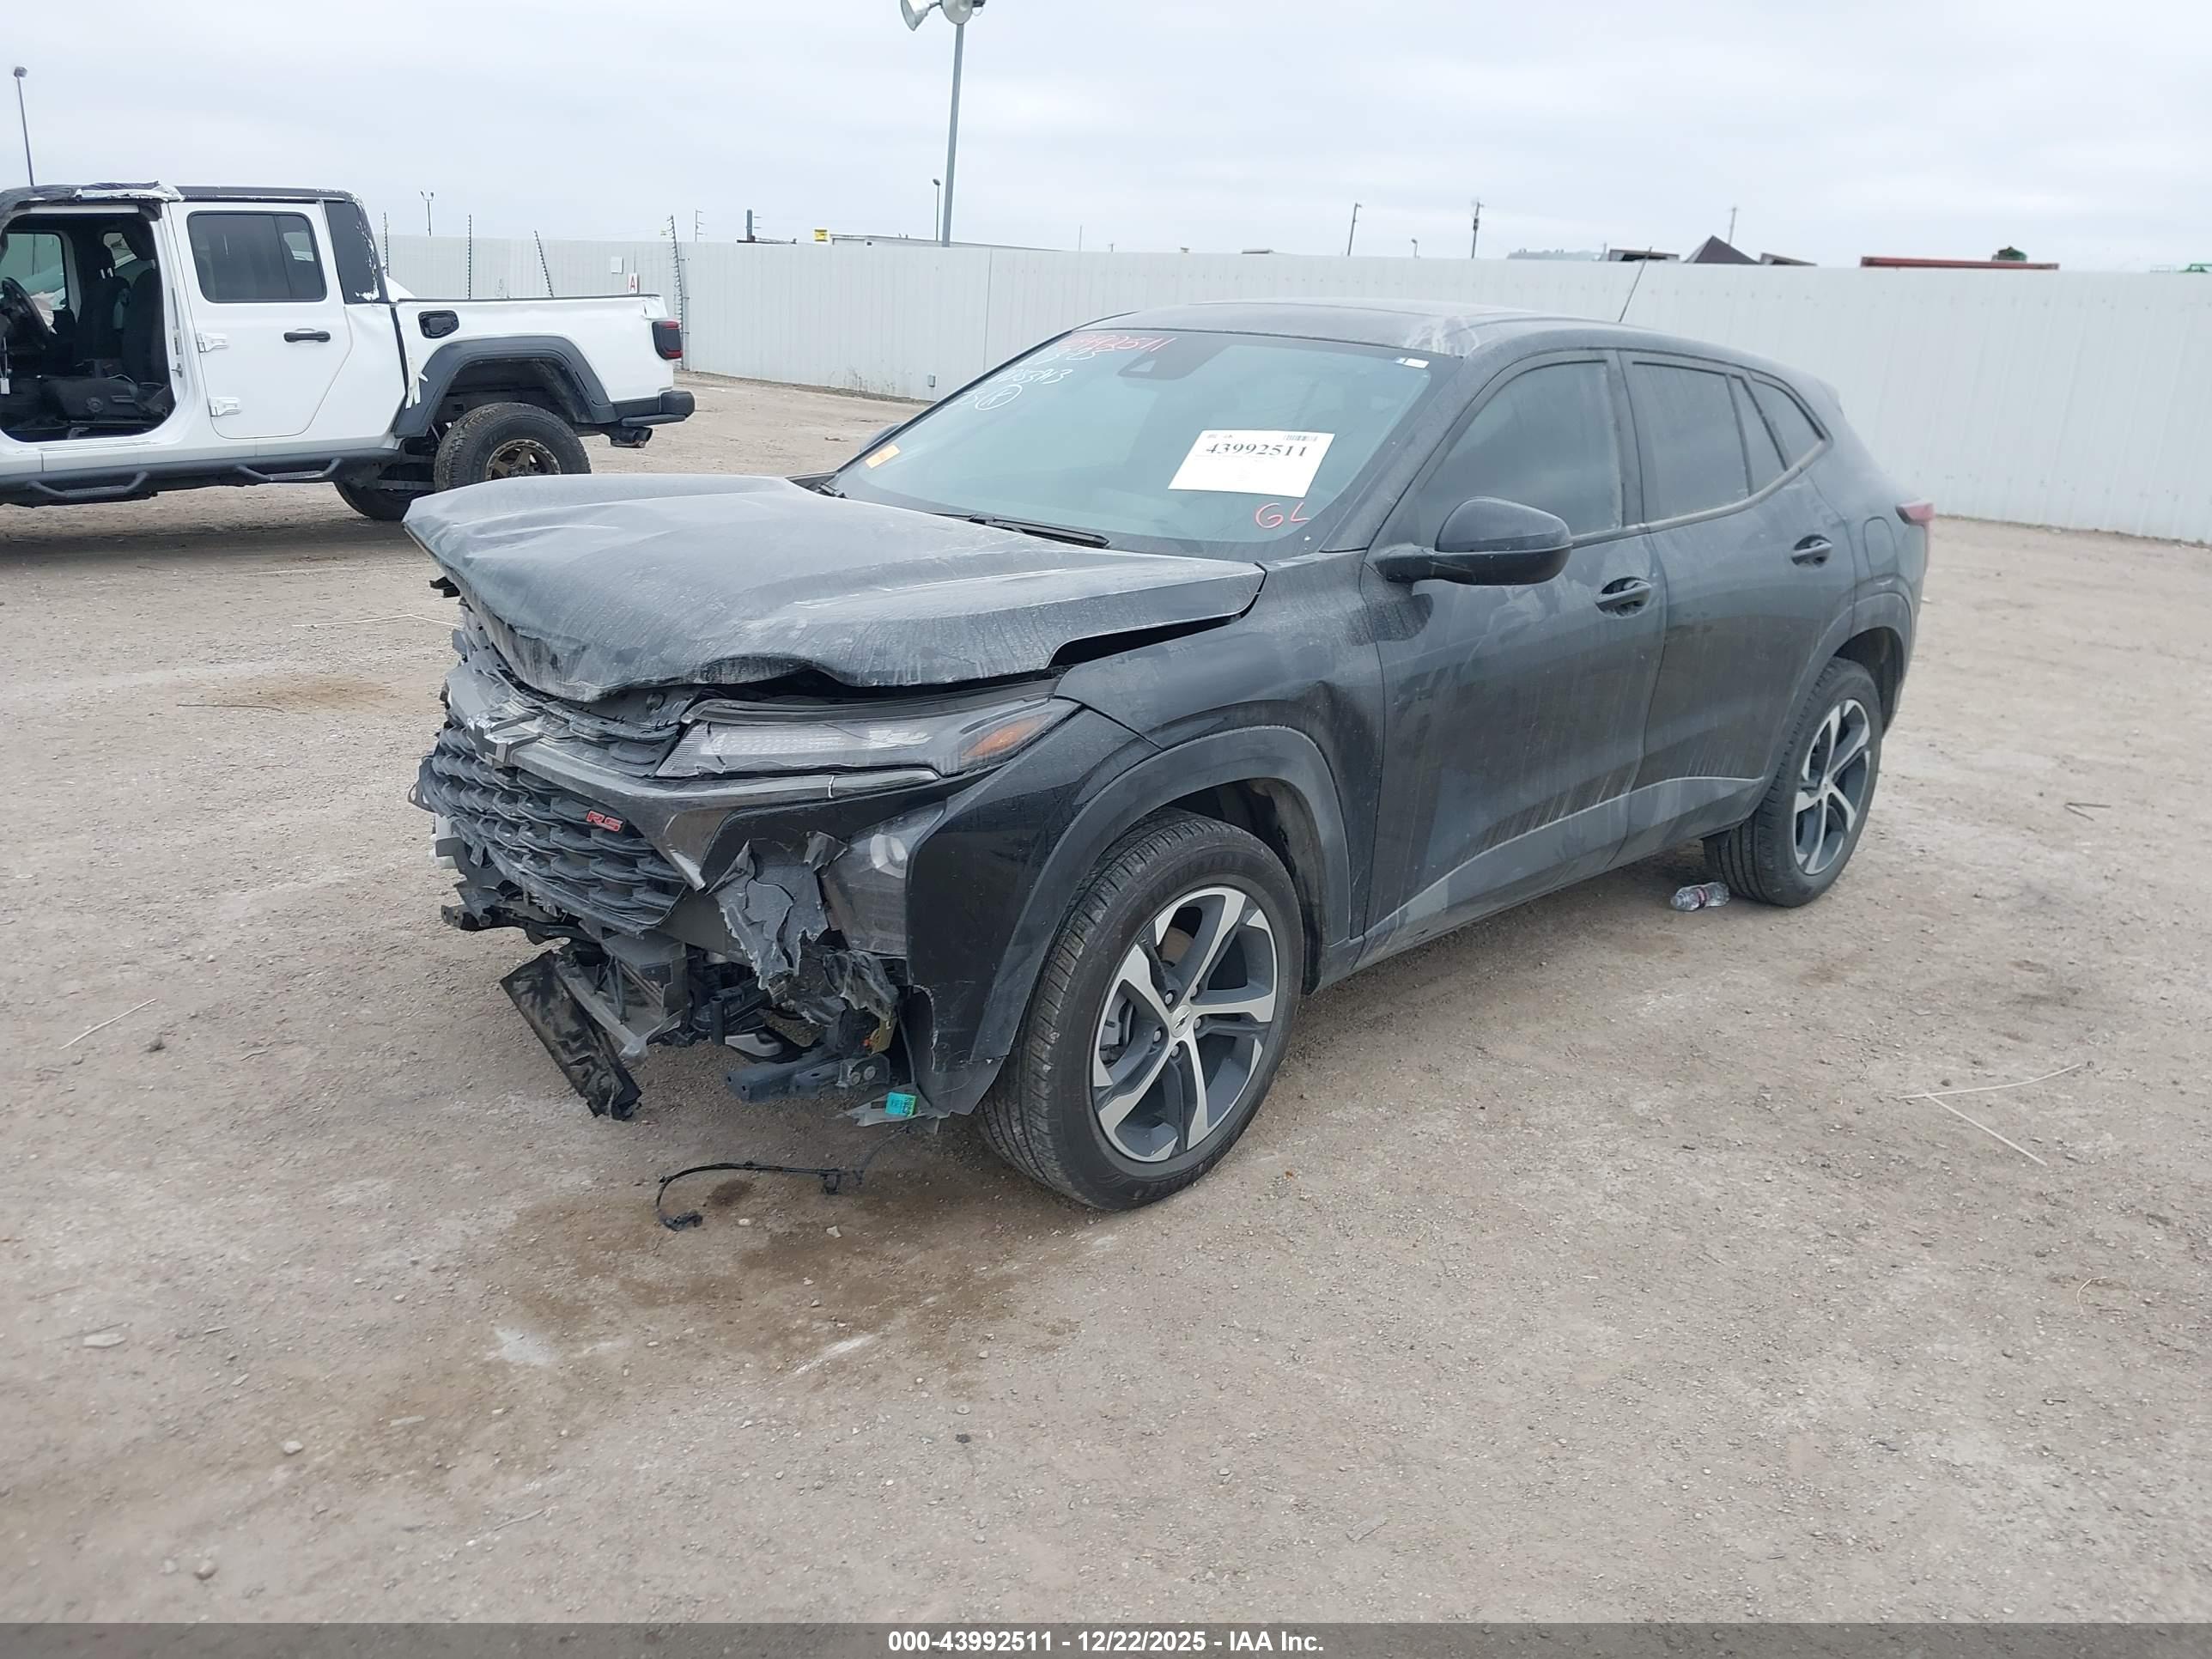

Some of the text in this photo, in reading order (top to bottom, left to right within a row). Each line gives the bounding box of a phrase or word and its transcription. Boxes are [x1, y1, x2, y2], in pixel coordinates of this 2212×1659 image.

[629, 275, 636, 292] A
[1206, 442, 1308, 457] 43992511
[586, 810, 623, 832] RS
